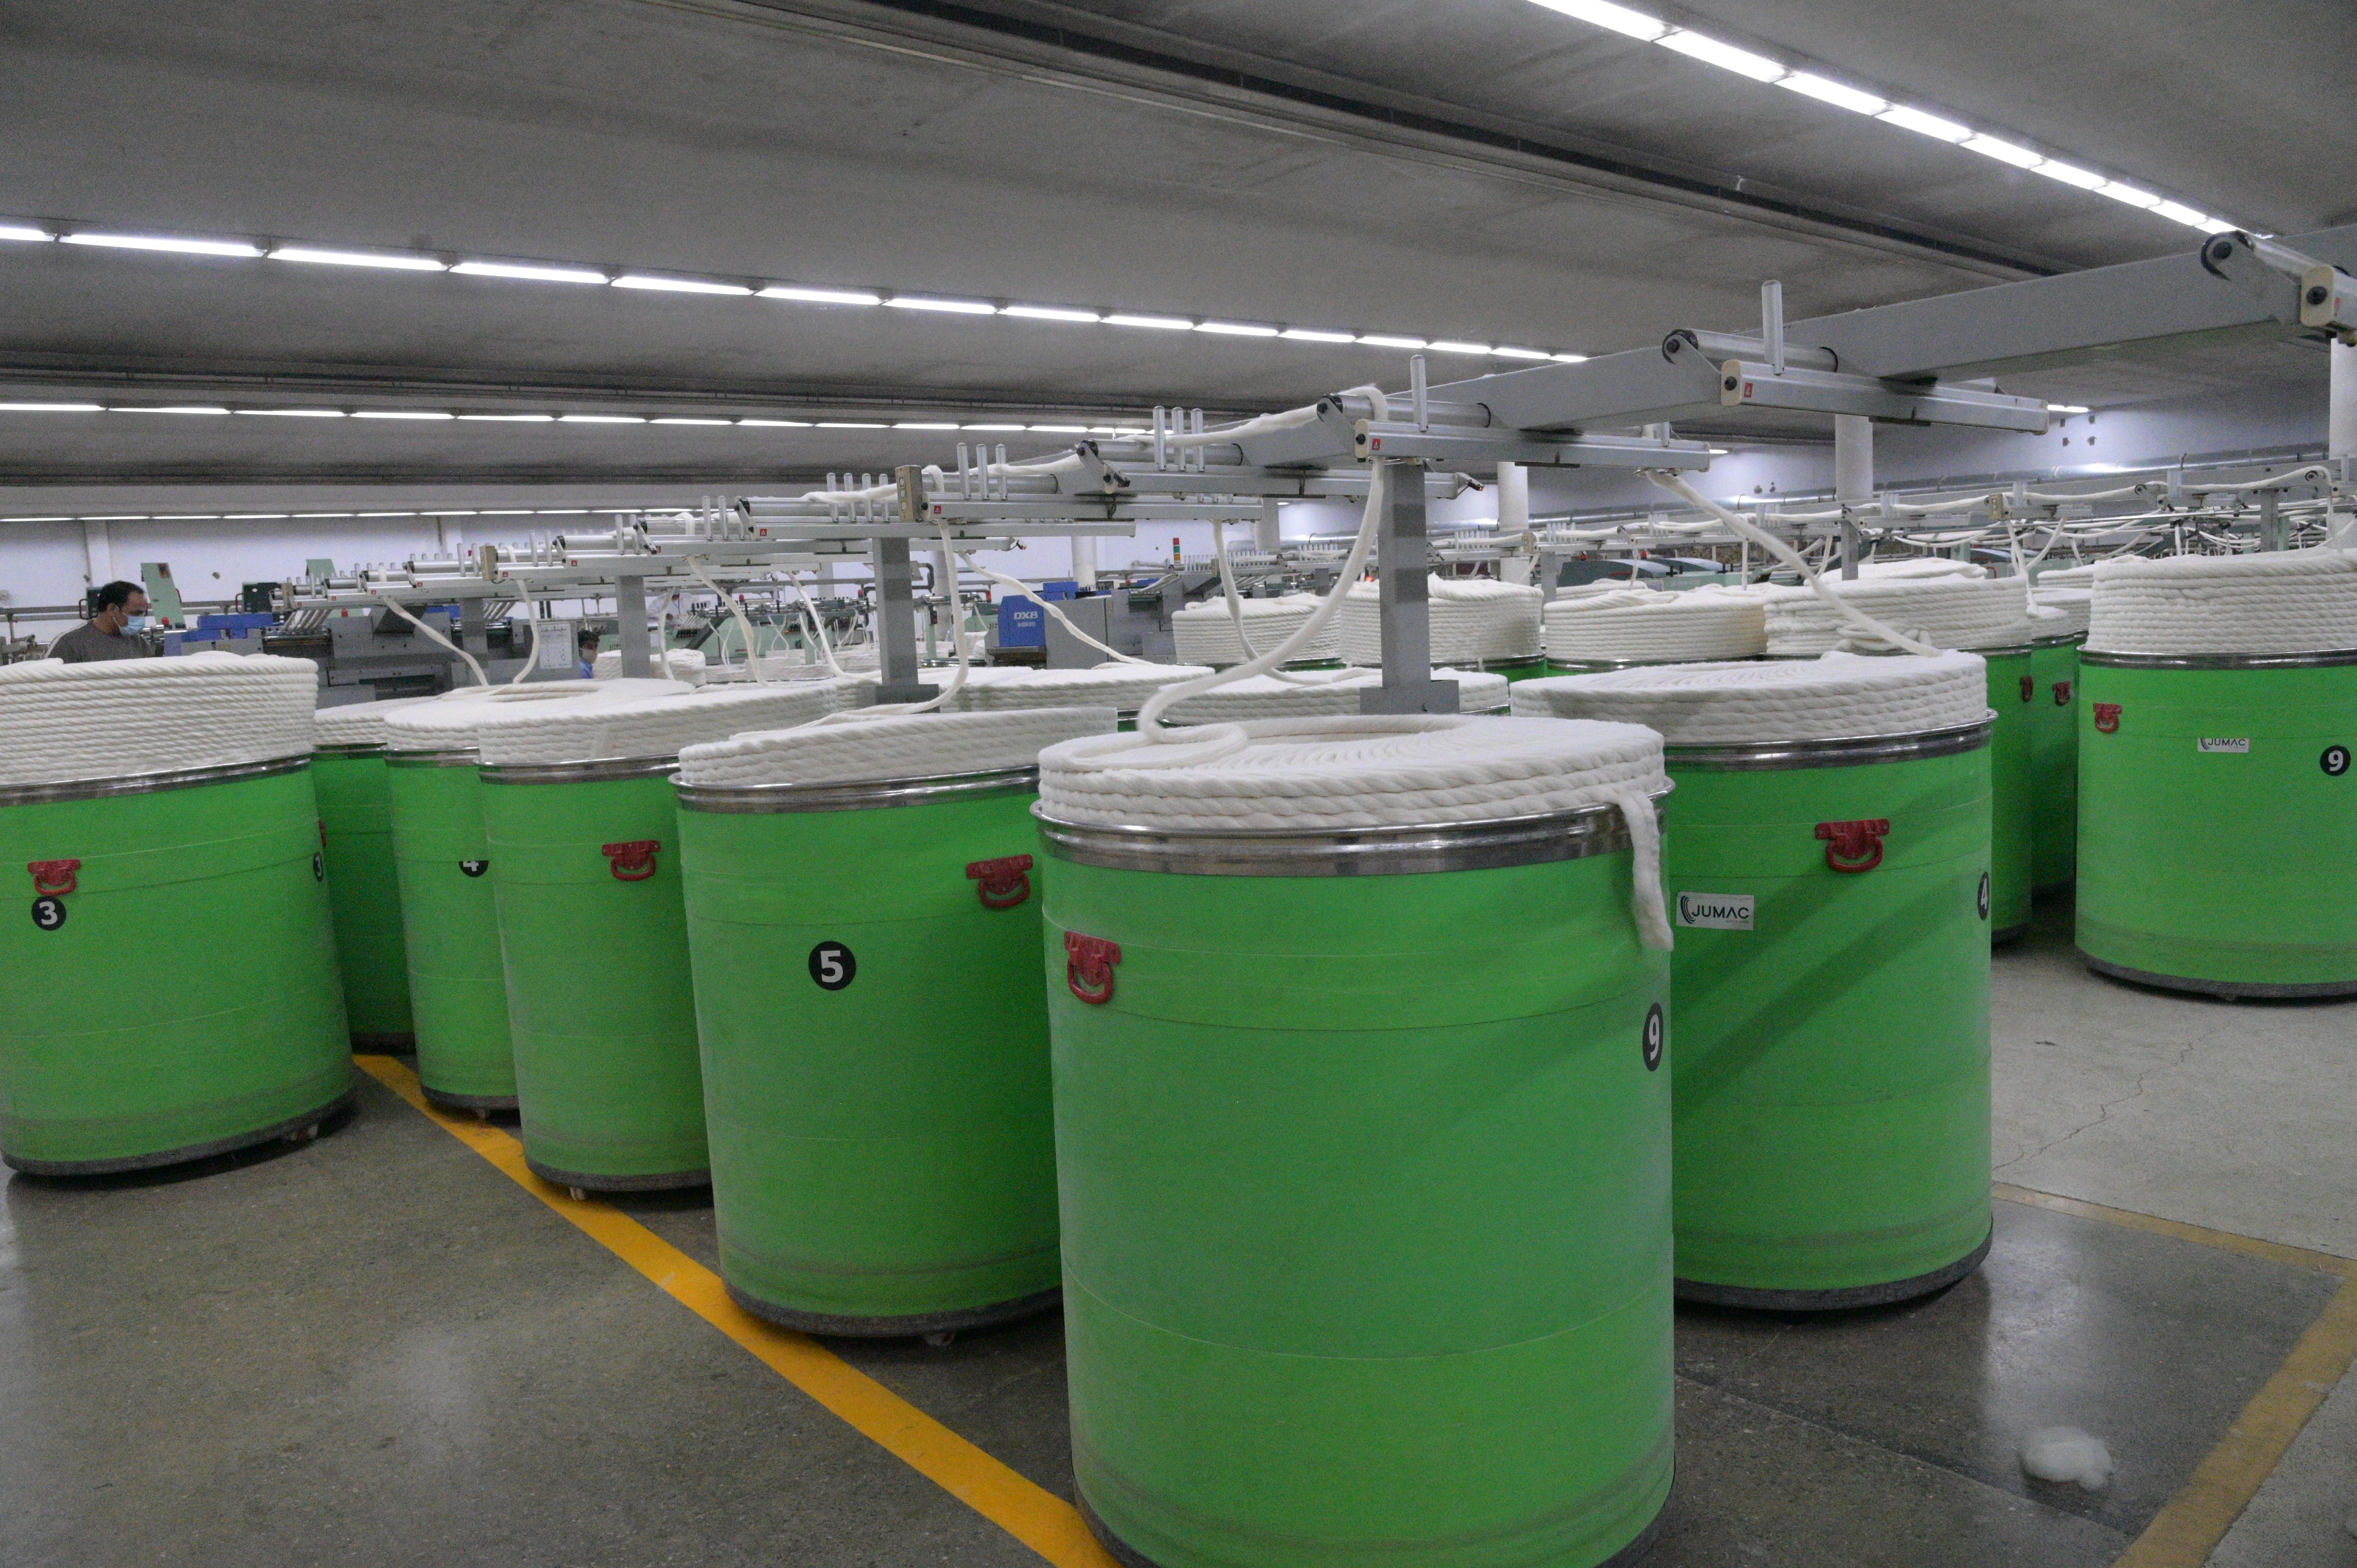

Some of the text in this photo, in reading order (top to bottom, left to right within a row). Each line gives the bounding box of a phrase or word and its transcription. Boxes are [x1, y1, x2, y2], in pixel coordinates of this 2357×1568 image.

[1014, 611, 1038, 620] DX8
[2328, 750, 2343, 771] 9
[315, 856, 322, 877] 3
[1981, 878, 1988, 909] 4
[39, 901, 58, 925] 3
[1692, 905, 1749, 919] JUMAC
[820, 950, 843, 983] 5
[1649, 1014, 1659, 1061] 9
